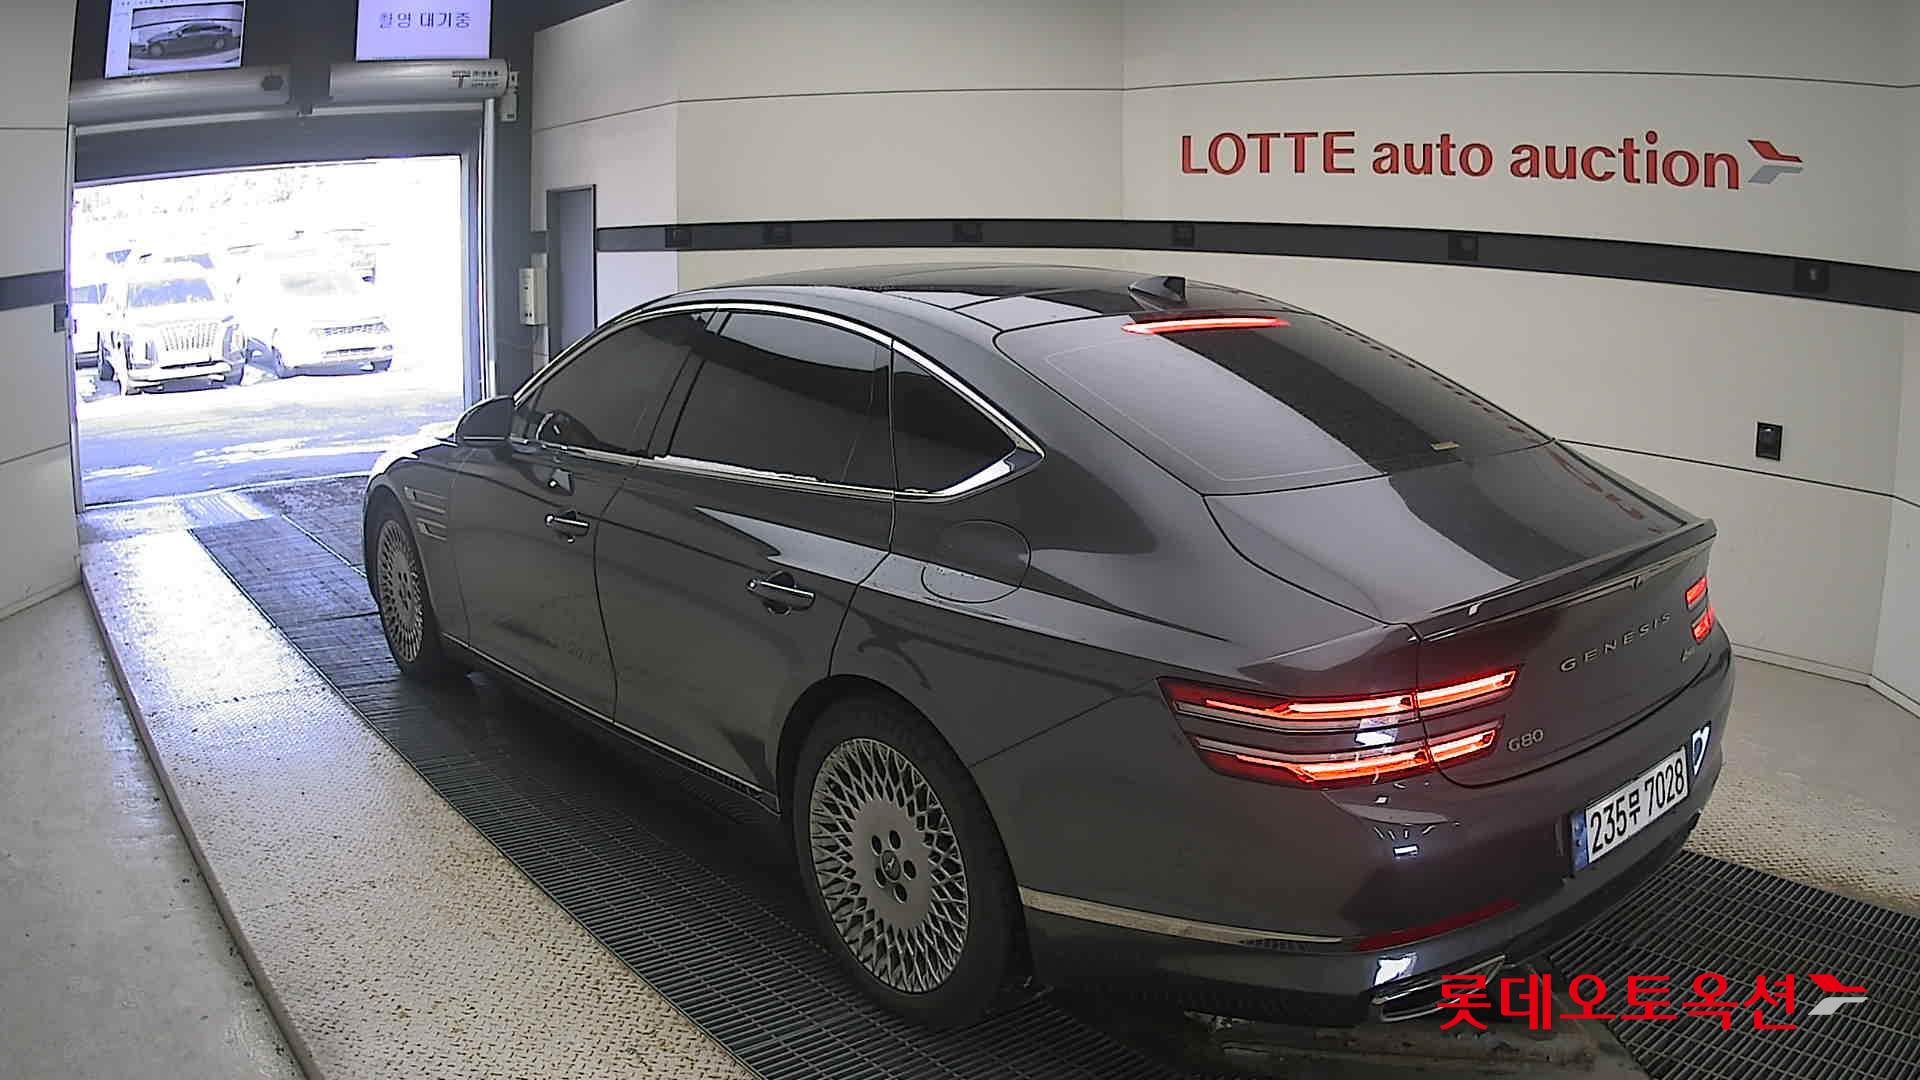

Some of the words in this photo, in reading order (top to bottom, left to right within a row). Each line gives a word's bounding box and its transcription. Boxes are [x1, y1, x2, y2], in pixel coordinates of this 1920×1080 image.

[419, 11, 472, 30] 대기중
[1181, 131, 1357, 176] LOTTE
[1372, 133, 1494, 178] auto
[1510, 131, 1741, 190] auction
[1560, 612, 1672, 673] GENESIS
[1508, 728, 1544, 752] G80
[1590, 789, 1641, 854] 235무
[1644, 758, 1685, 817] 7028
